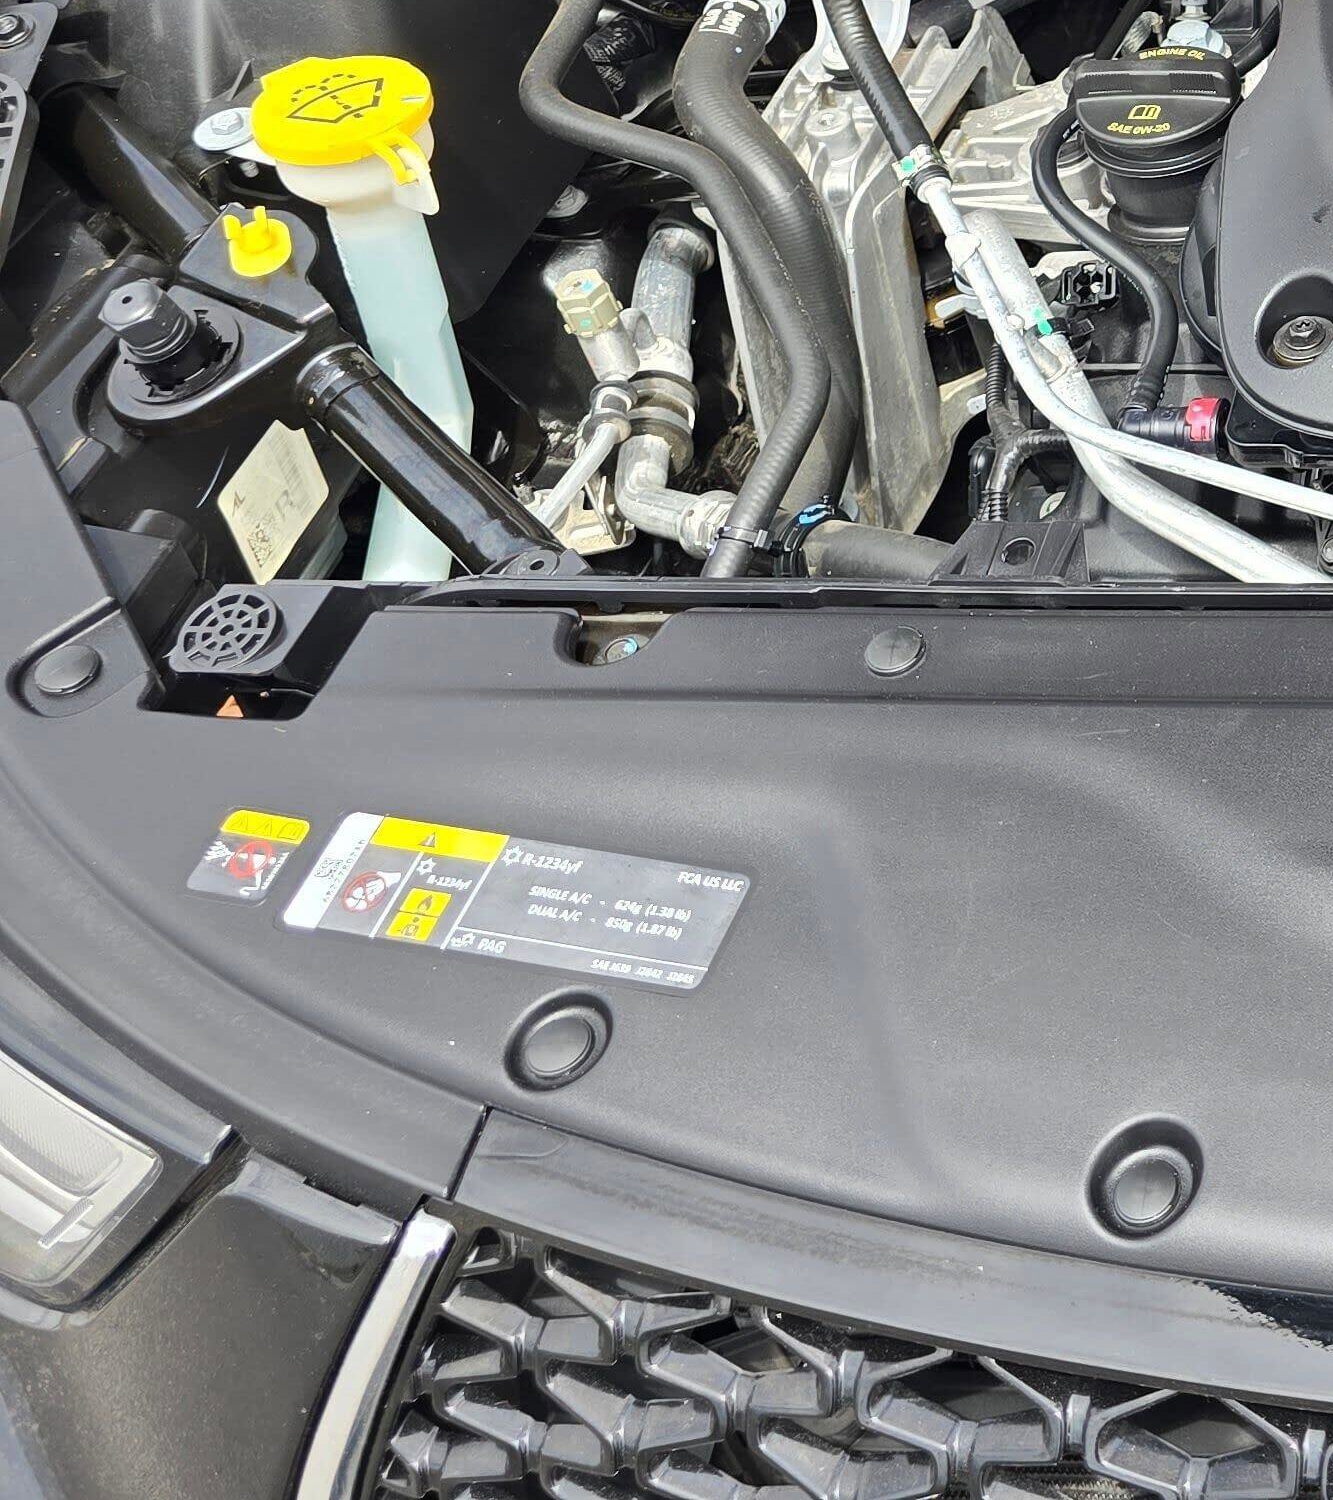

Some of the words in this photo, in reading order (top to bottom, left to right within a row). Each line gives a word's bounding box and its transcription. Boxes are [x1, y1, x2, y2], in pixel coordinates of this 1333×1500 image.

[1138, 47, 1187, 60] ENGINE
[1188, 49, 1206, 61] OIL
[1107, 122, 1132, 135] SAE
[1133, 122, 1171, 135] 0W-20
[521, 852, 584, 875] R-1234yf
[677, 871, 701, 886] FCA
[702, 875, 721, 888] US
[721, 878, 745, 892] LLC
[528, 885, 569, 901] SINGLE
[569, 891, 593, 905] A/C
[528, 904, 559, 919] DUAL
[559, 908, 583, 922] A/C
[477, 938, 506, 953] PAG
[591, 958, 610, 971] SAE
